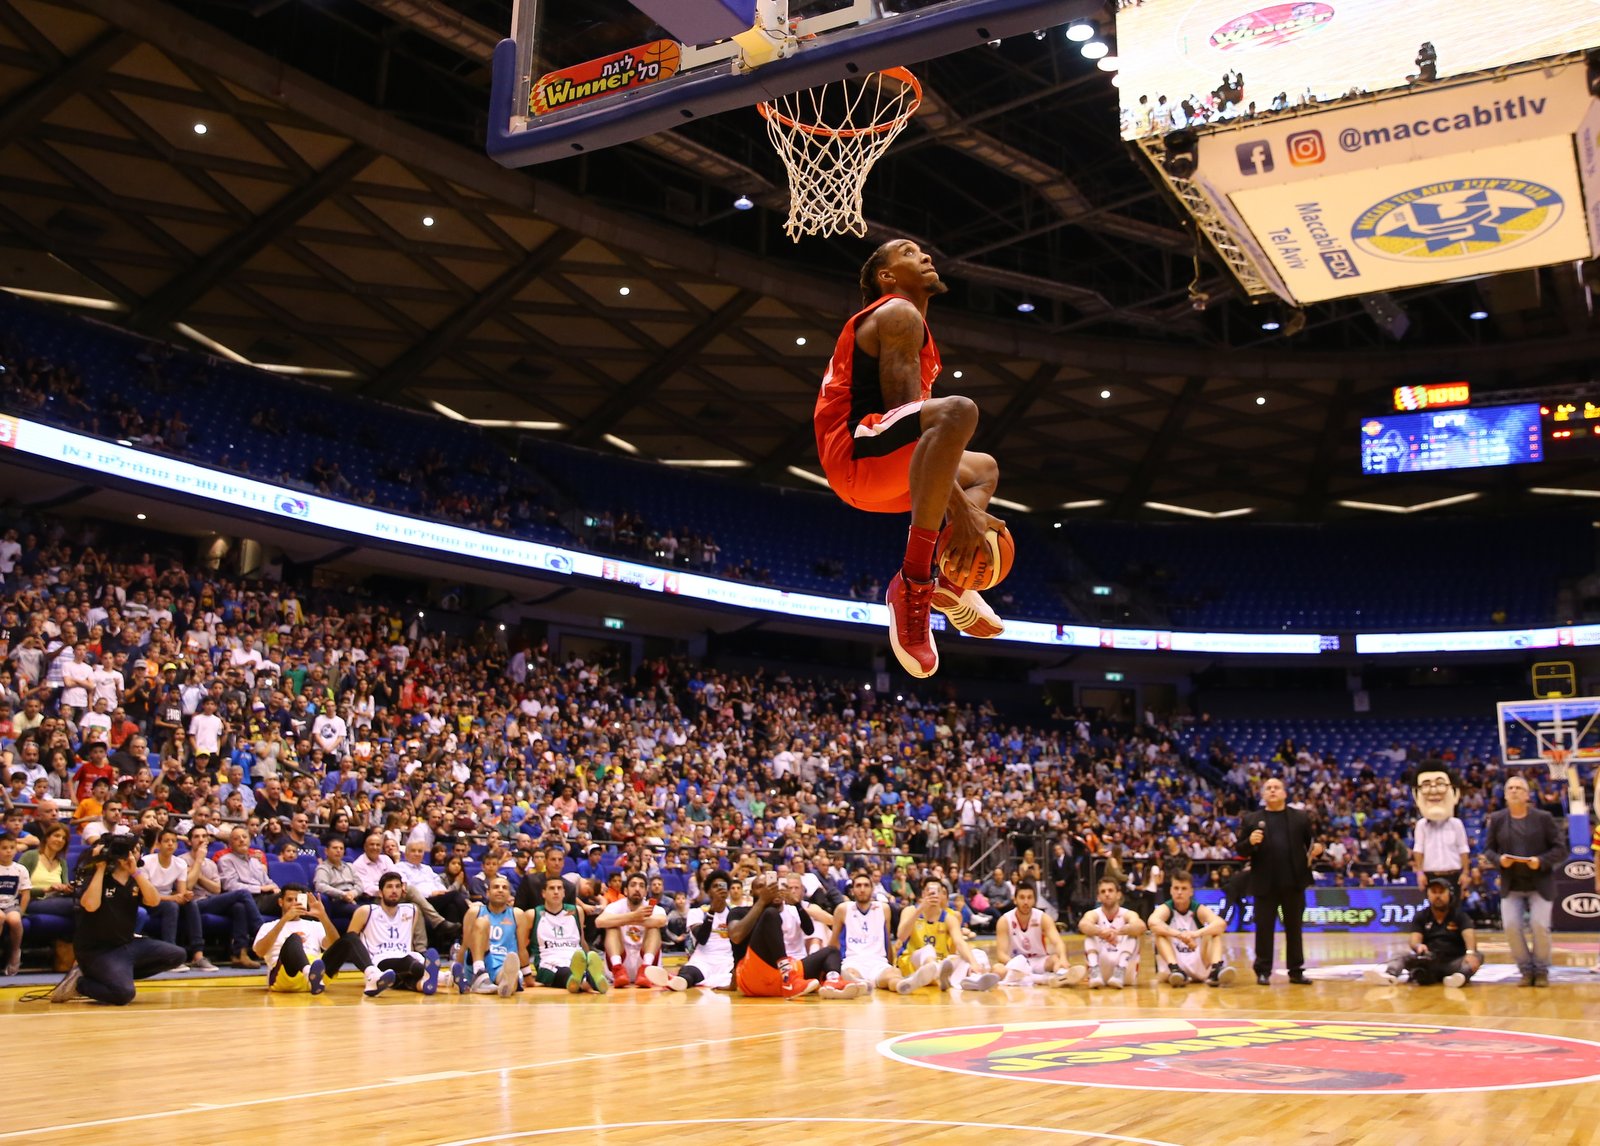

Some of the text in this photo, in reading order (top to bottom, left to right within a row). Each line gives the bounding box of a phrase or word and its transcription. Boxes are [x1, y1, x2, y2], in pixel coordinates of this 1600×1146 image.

[601, 55, 634, 77] ליגת
[637, 62, 660, 81] סל
[546, 70, 636, 106] Winner
[1338, 95, 1548, 152] @maccabitlv
[1268, 227, 1309, 269] Tel Aviv
[1294, 202, 1357, 279] Maccabi FOX
